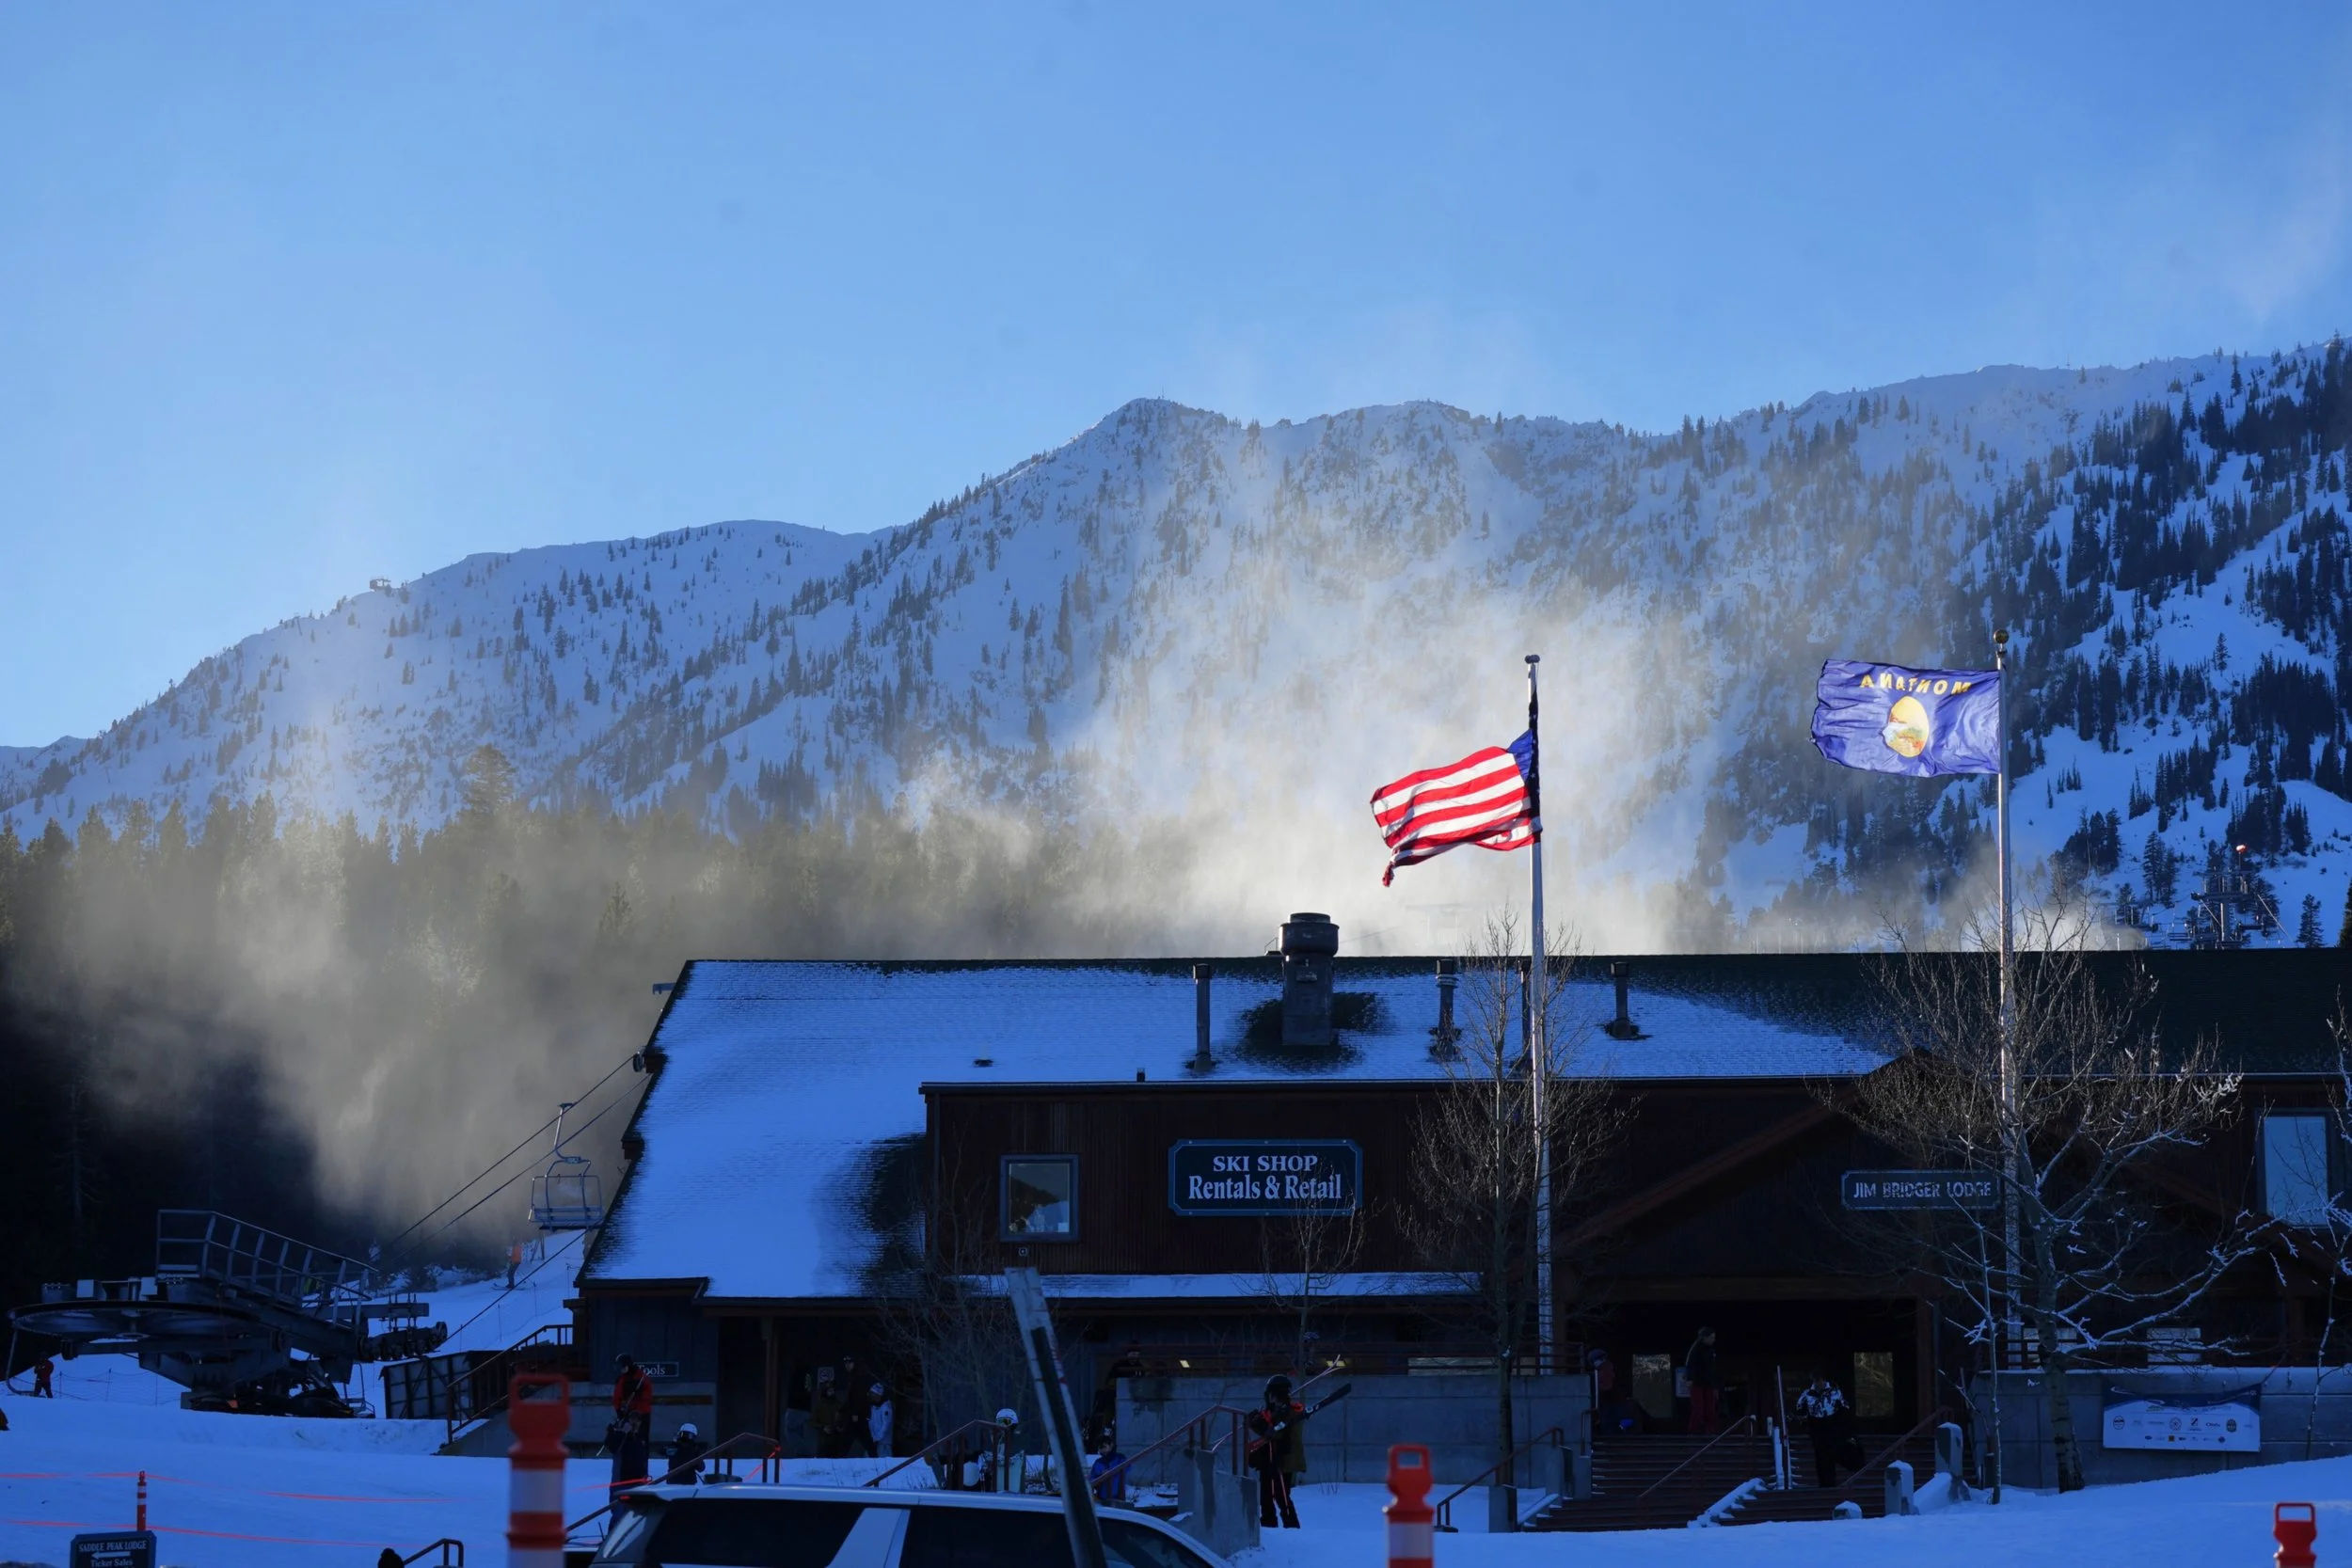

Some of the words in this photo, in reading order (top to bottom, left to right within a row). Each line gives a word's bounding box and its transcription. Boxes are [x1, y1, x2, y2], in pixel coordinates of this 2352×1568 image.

[1213, 1155, 1250, 1172] SKI
[1257, 1155, 1318, 1172] SHOP
[1188, 1174, 1261, 1199] Rentals
[1264, 1175, 1280, 1199] &
[1284, 1174, 1342, 1199] Retail
[1853, 1182, 1877, 1198] JIM
[1883, 1181, 1941, 1198] BRIDGER
[1947, 1181, 1992, 1197] LODGE
[78, 1542, 105, 1552] SADDLE
[106, 1541, 123, 1551] PEAK
[124, 1540, 148, 1550] LODGE
[90, 1559, 113, 1568] Ticket
[114, 1558, 134, 1567] Sales
